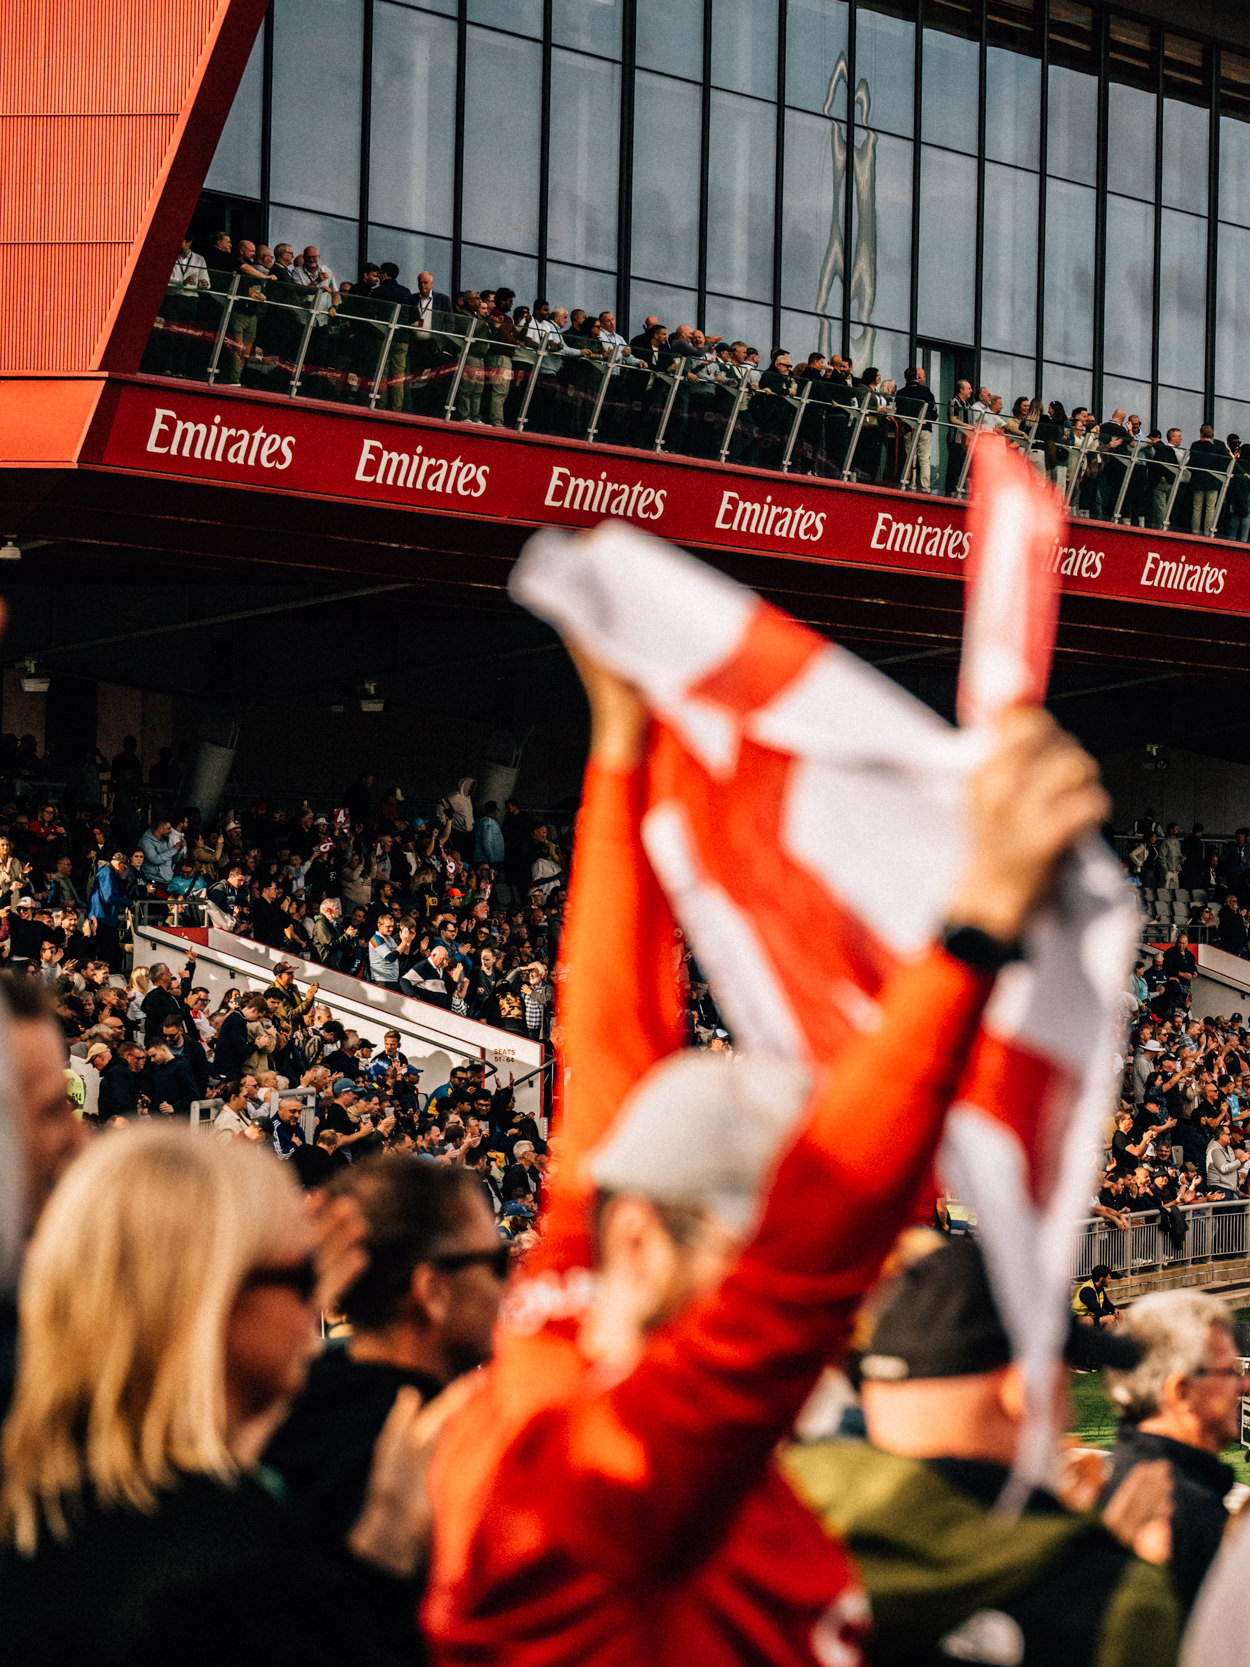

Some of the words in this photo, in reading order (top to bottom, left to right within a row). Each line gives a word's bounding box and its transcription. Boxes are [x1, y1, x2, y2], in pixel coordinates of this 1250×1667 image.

[147, 408, 297, 470] Emirates
[356, 439, 489, 498] Emirates
[545, 467, 667, 520] Emirates
[714, 491, 827, 542] Emirates
[870, 512, 974, 560] Emirates
[1044, 537, 1105, 578] irates
[1140, 552, 1228, 595] Emirates
[493, 1048, 516, 1056] SEATS
